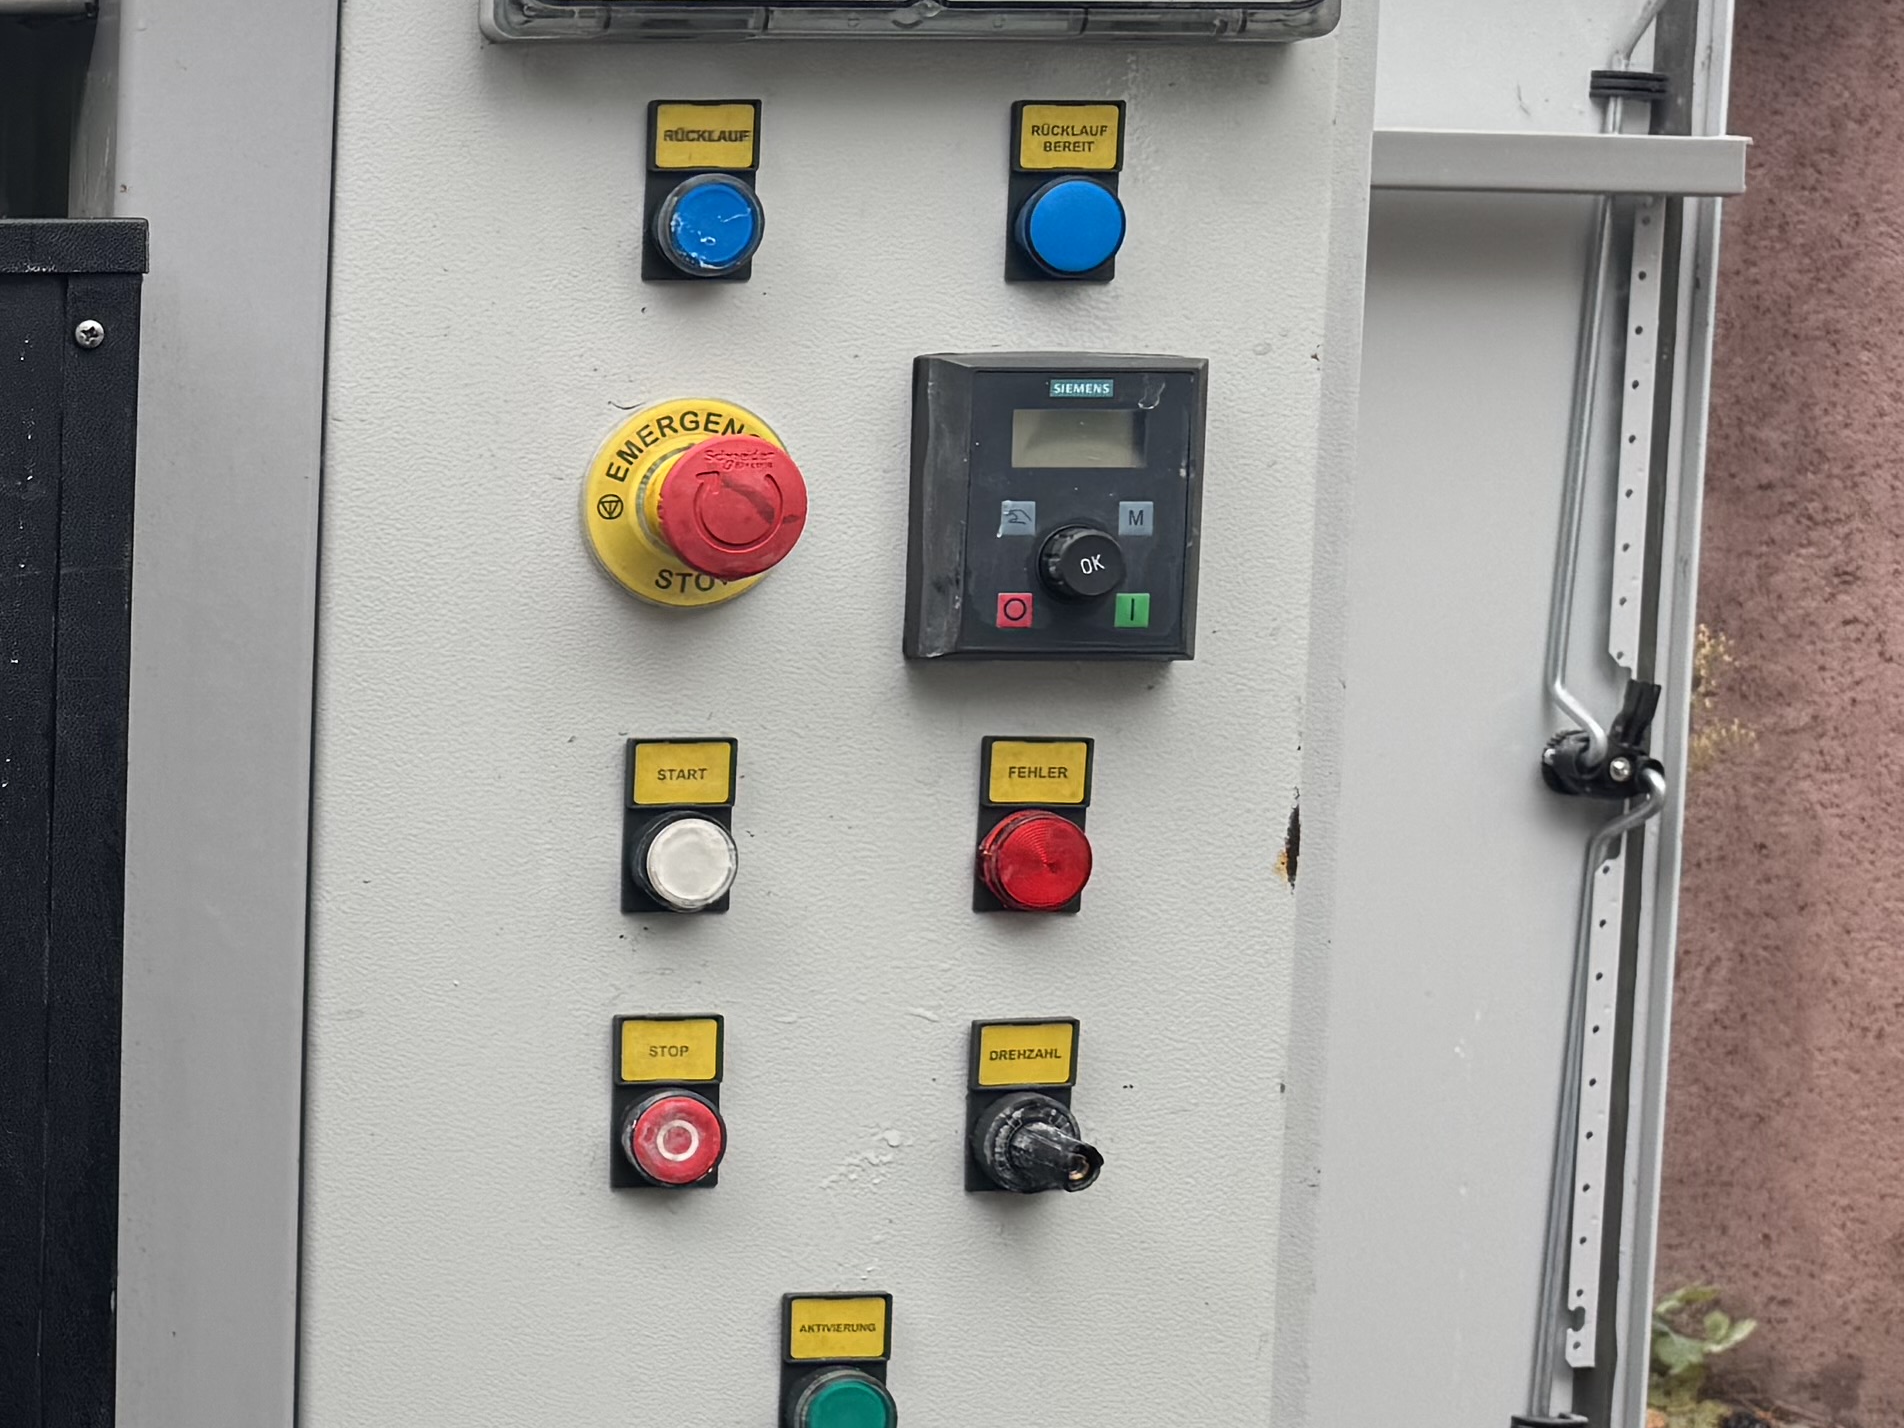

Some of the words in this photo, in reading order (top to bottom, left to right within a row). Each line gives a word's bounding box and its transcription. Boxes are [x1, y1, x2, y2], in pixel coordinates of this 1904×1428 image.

[663, 127, 752, 143] RÜCKLAUF
[1031, 123, 1109, 137] RÜCKLAUF
[1043, 140, 1095, 153] BEREIT
[1053, 383, 1111, 395] SIEMENS
[605, 410, 760, 483] EMERGEN
[1128, 509, 1144, 526] M
[1080, 553, 1106, 575] OK
[654, 568, 729, 594] STO
[656, 766, 708, 783] START
[1007, 765, 1069, 780] FEHLER
[648, 1043, 690, 1059] STOP
[988, 1048, 1062, 1061] DREHZAHL
[799, 1323, 877, 1333] AKTIVIERUNG
